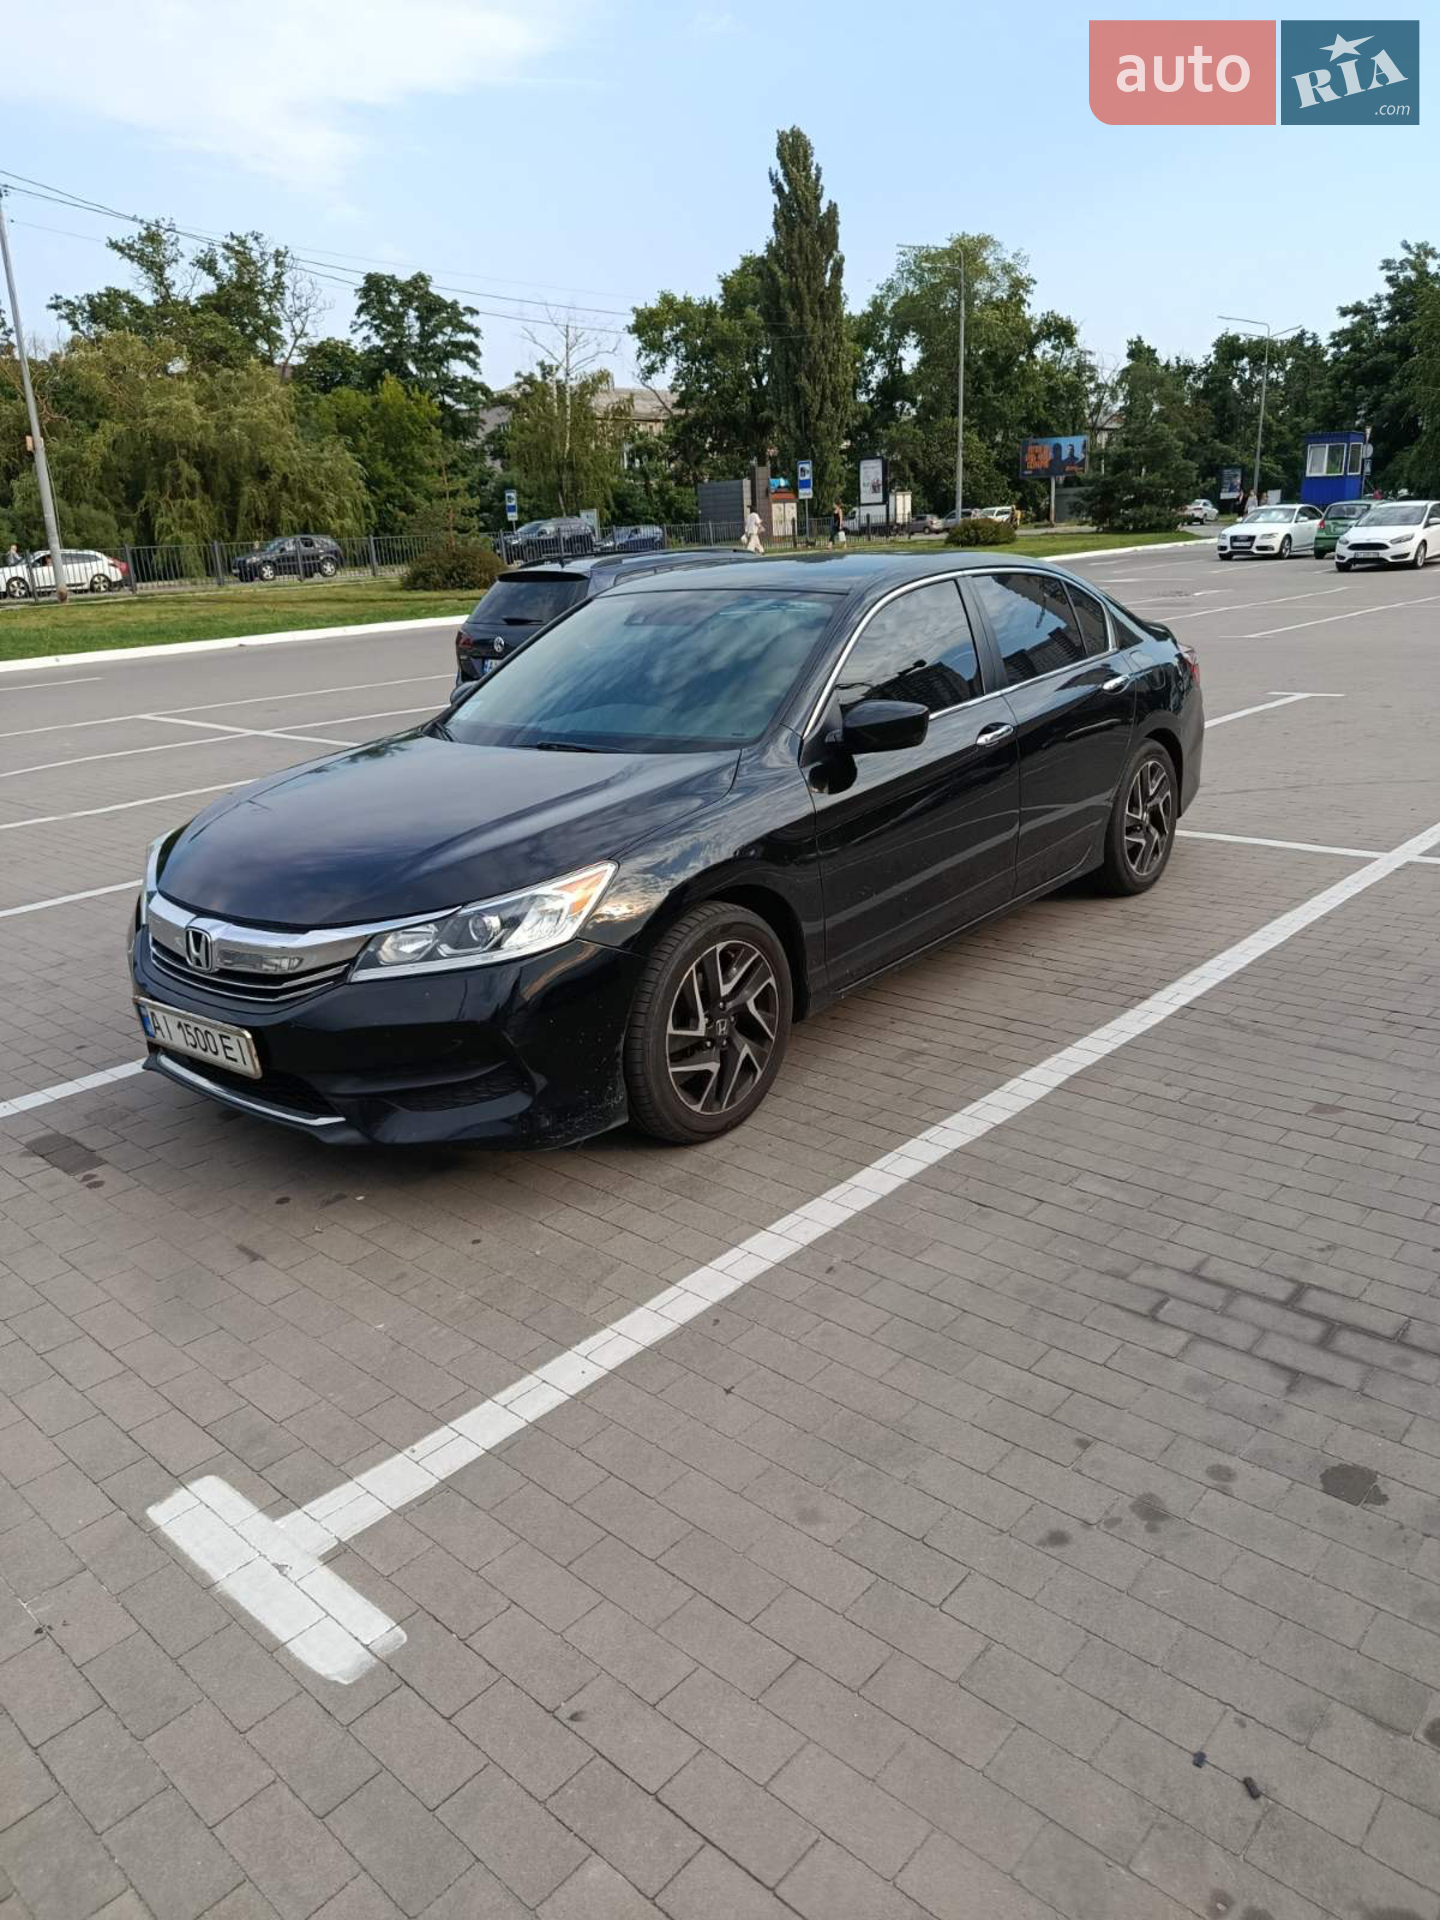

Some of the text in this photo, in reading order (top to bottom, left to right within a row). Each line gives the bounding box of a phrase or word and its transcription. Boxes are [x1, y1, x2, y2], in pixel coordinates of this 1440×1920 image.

[150, 1011, 247, 1066] AI 1500 EI
